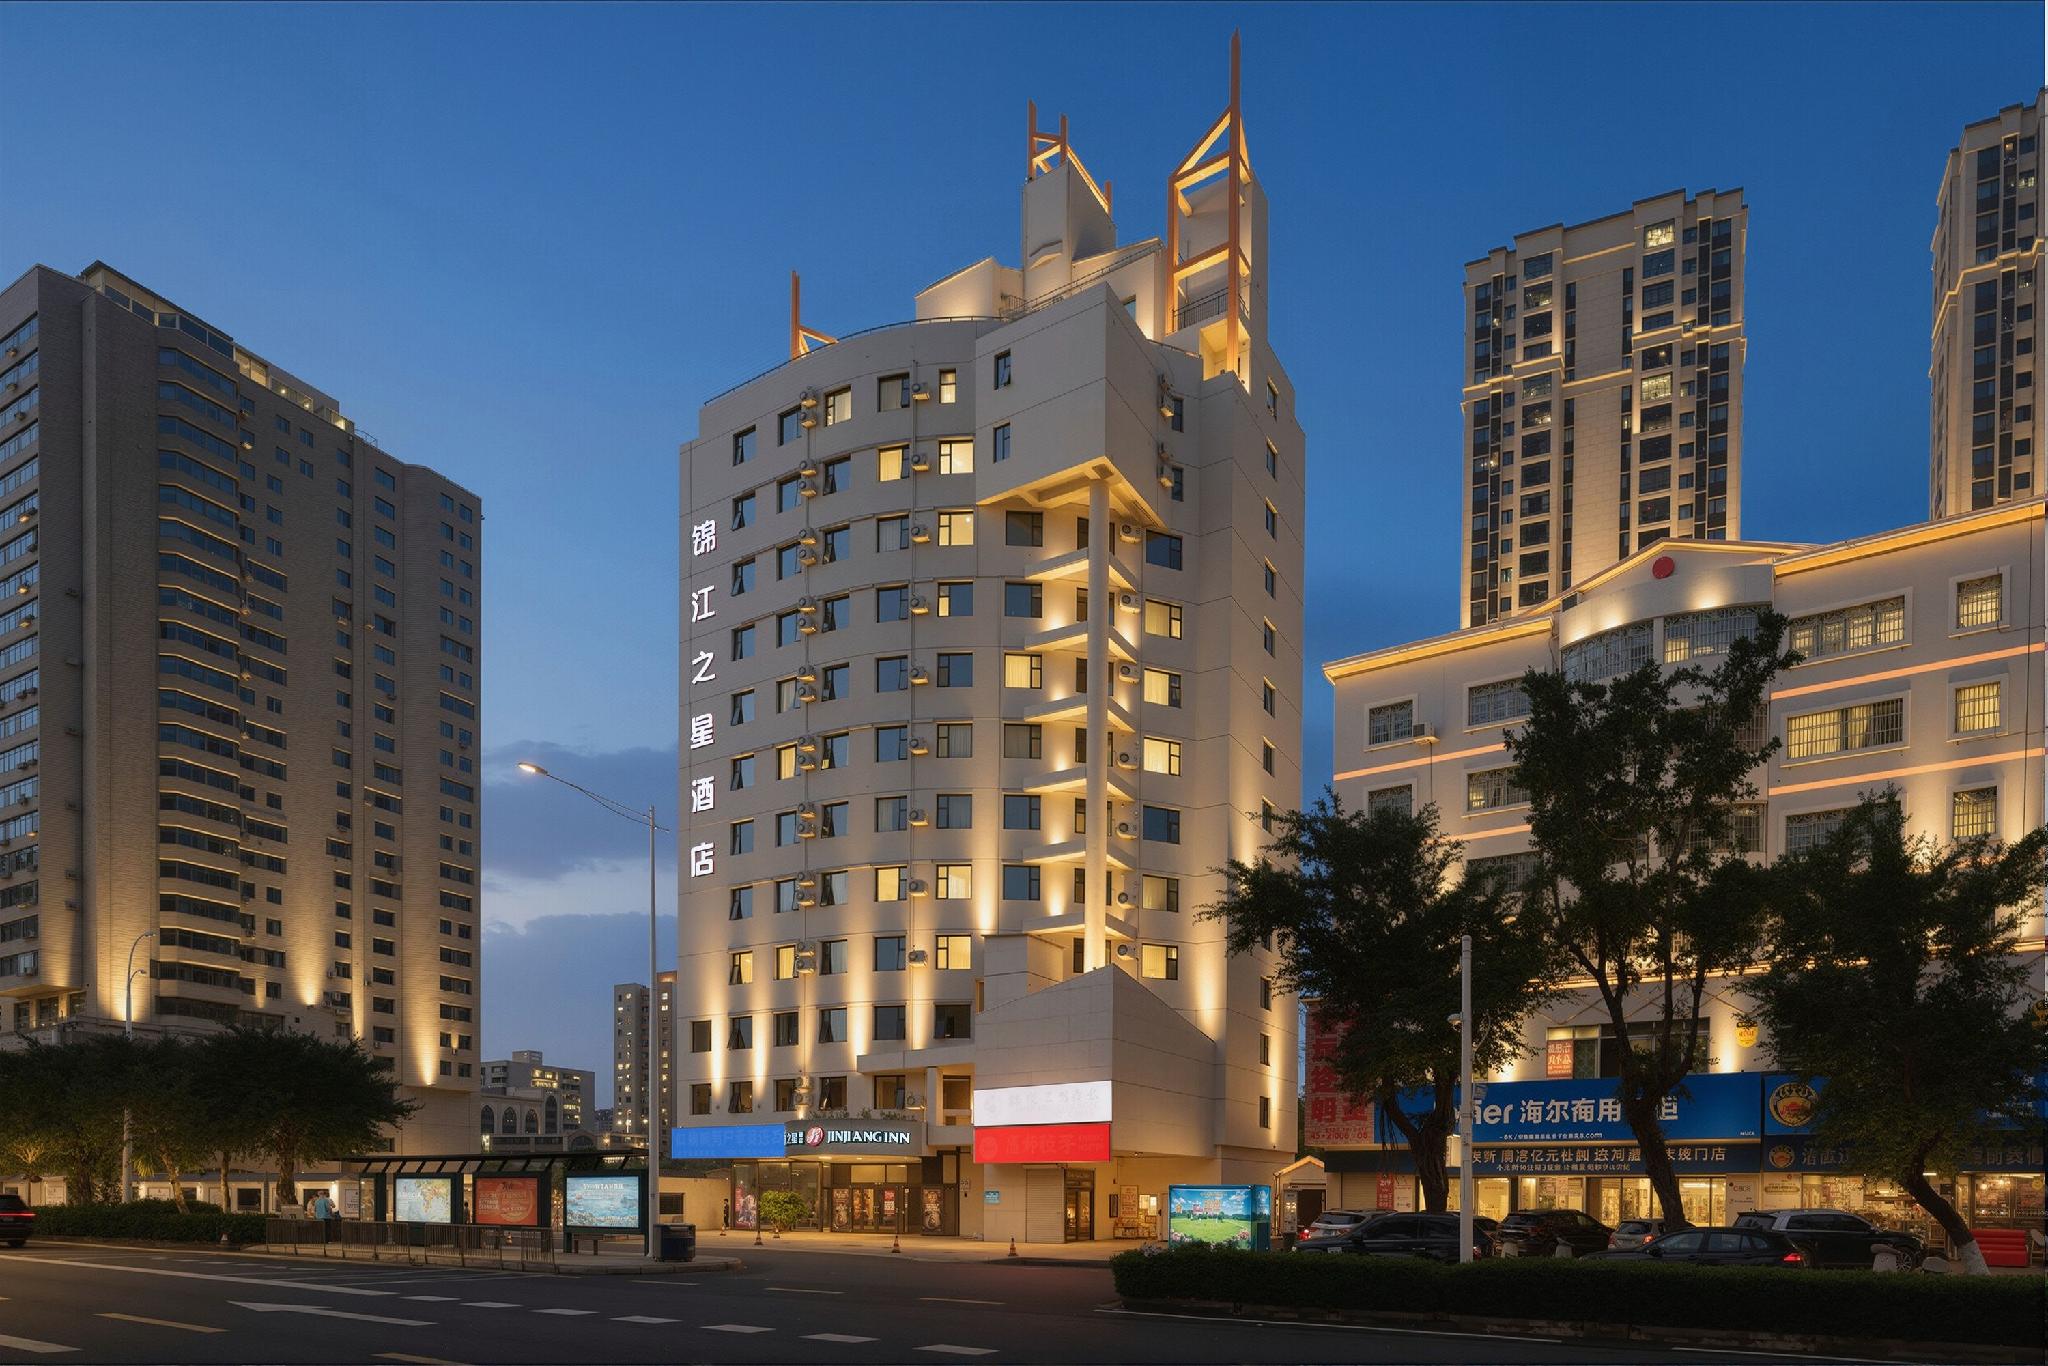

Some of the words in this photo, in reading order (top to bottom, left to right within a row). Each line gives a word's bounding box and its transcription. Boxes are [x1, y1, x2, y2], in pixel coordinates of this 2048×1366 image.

[691, 519, 716, 878] 锦江之星酒店
[827, 1130, 882, 1144] JINJIANG
[883, 1132, 911, 1144] INN
